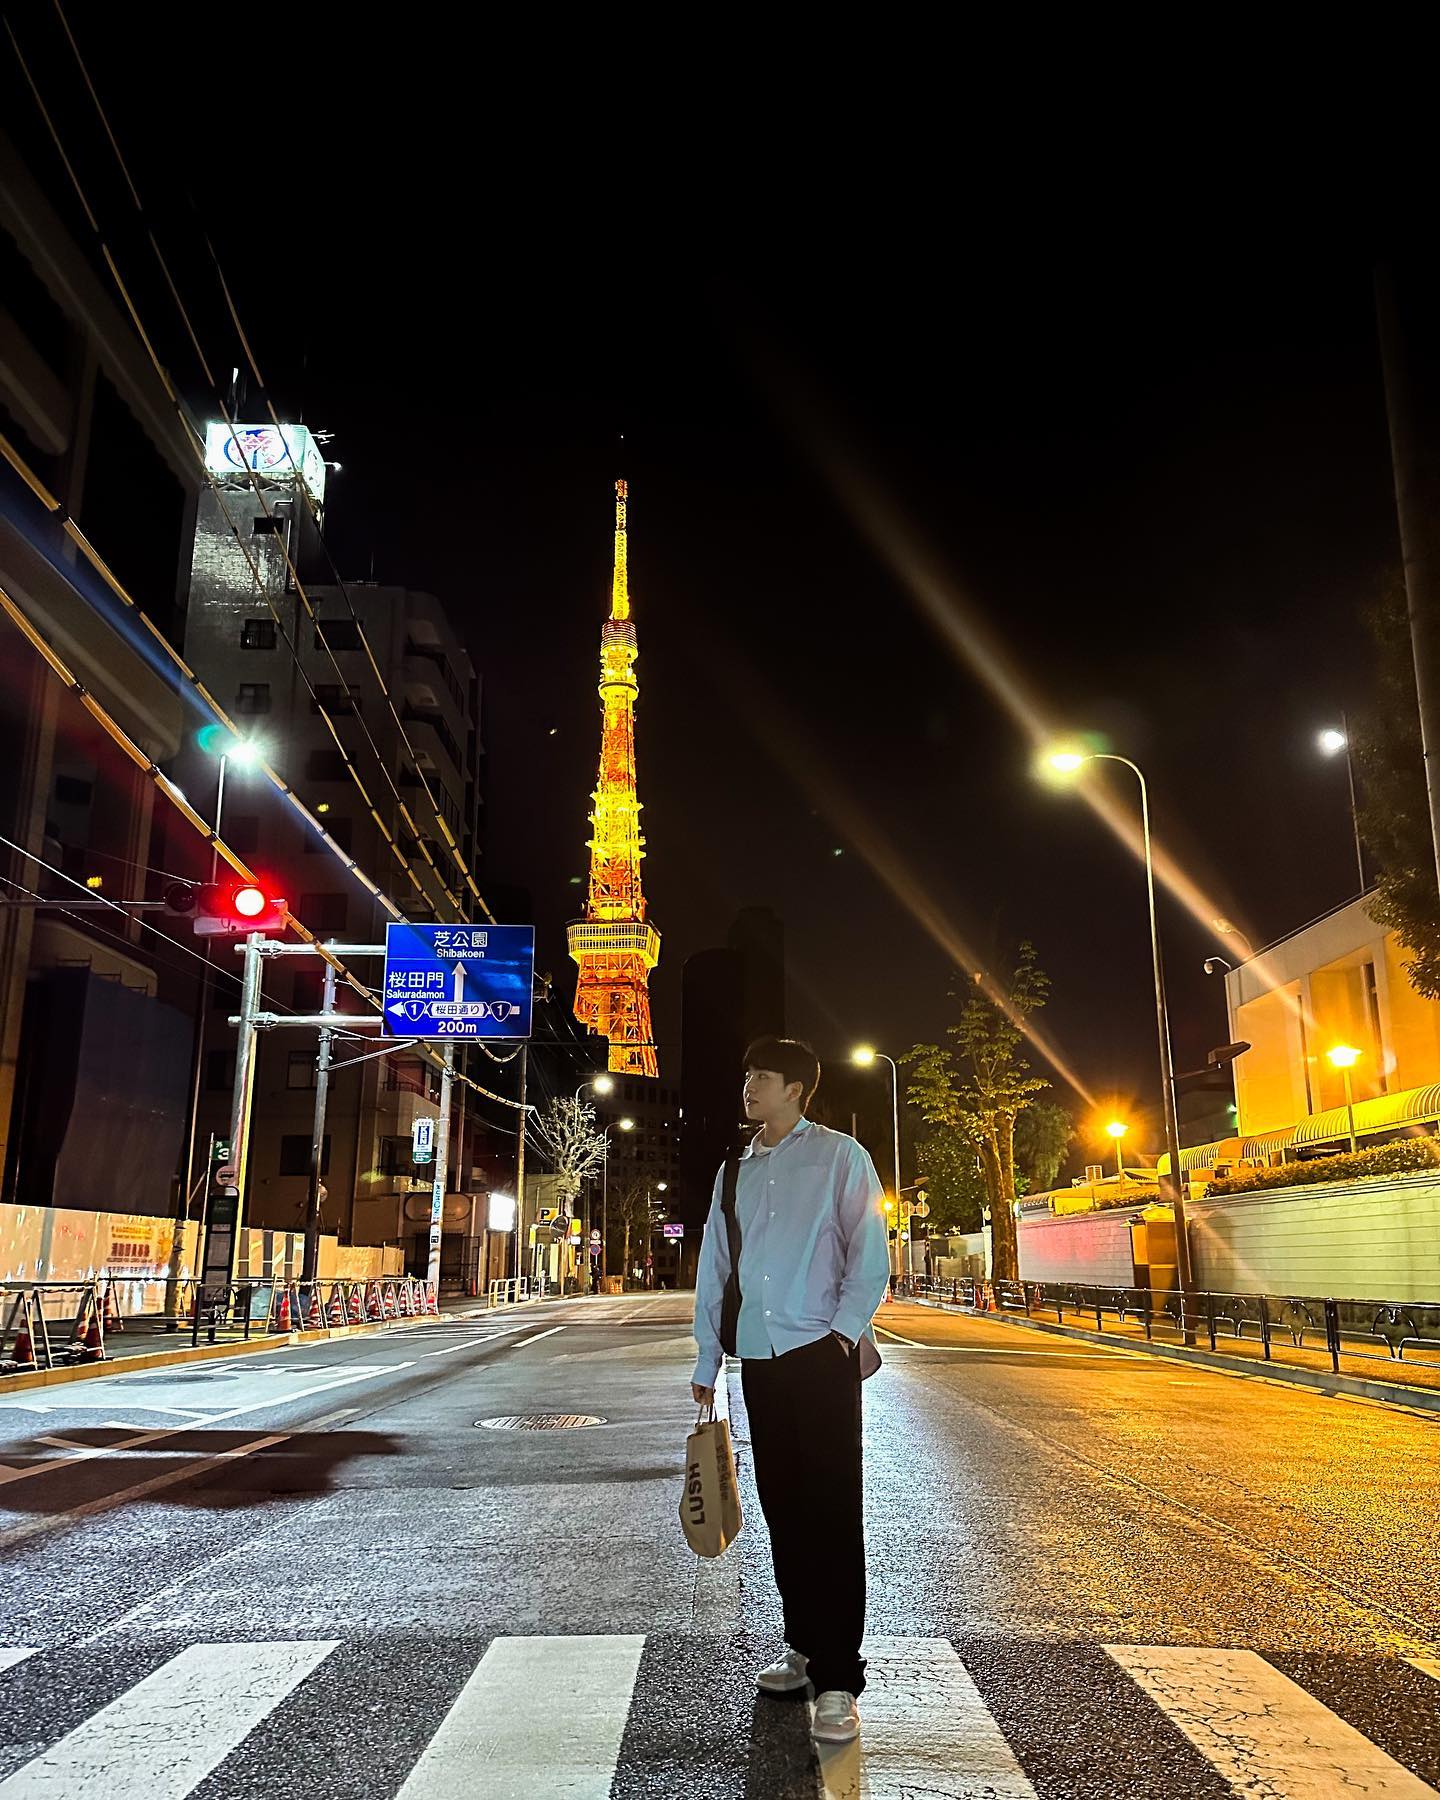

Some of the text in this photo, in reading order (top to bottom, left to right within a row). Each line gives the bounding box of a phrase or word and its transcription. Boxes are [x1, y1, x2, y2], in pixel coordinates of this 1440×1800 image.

[434, 931, 488, 948] 芝公園
[436, 948, 485, 958] Shibakoen
[388, 971, 444, 989] 桜田門
[386, 989, 445, 999] Sakuradamon
[410, 1003, 418, 1016] 1
[435, 1004, 480, 1015] 桜田通り
[496, 1004, 503, 1016] 1
[437, 1021, 477, 1033] 200m
[217, 1148, 230, 1160] 3
[541, 1209, 551, 1219] P
[688, 1463, 706, 1525] LUSH
